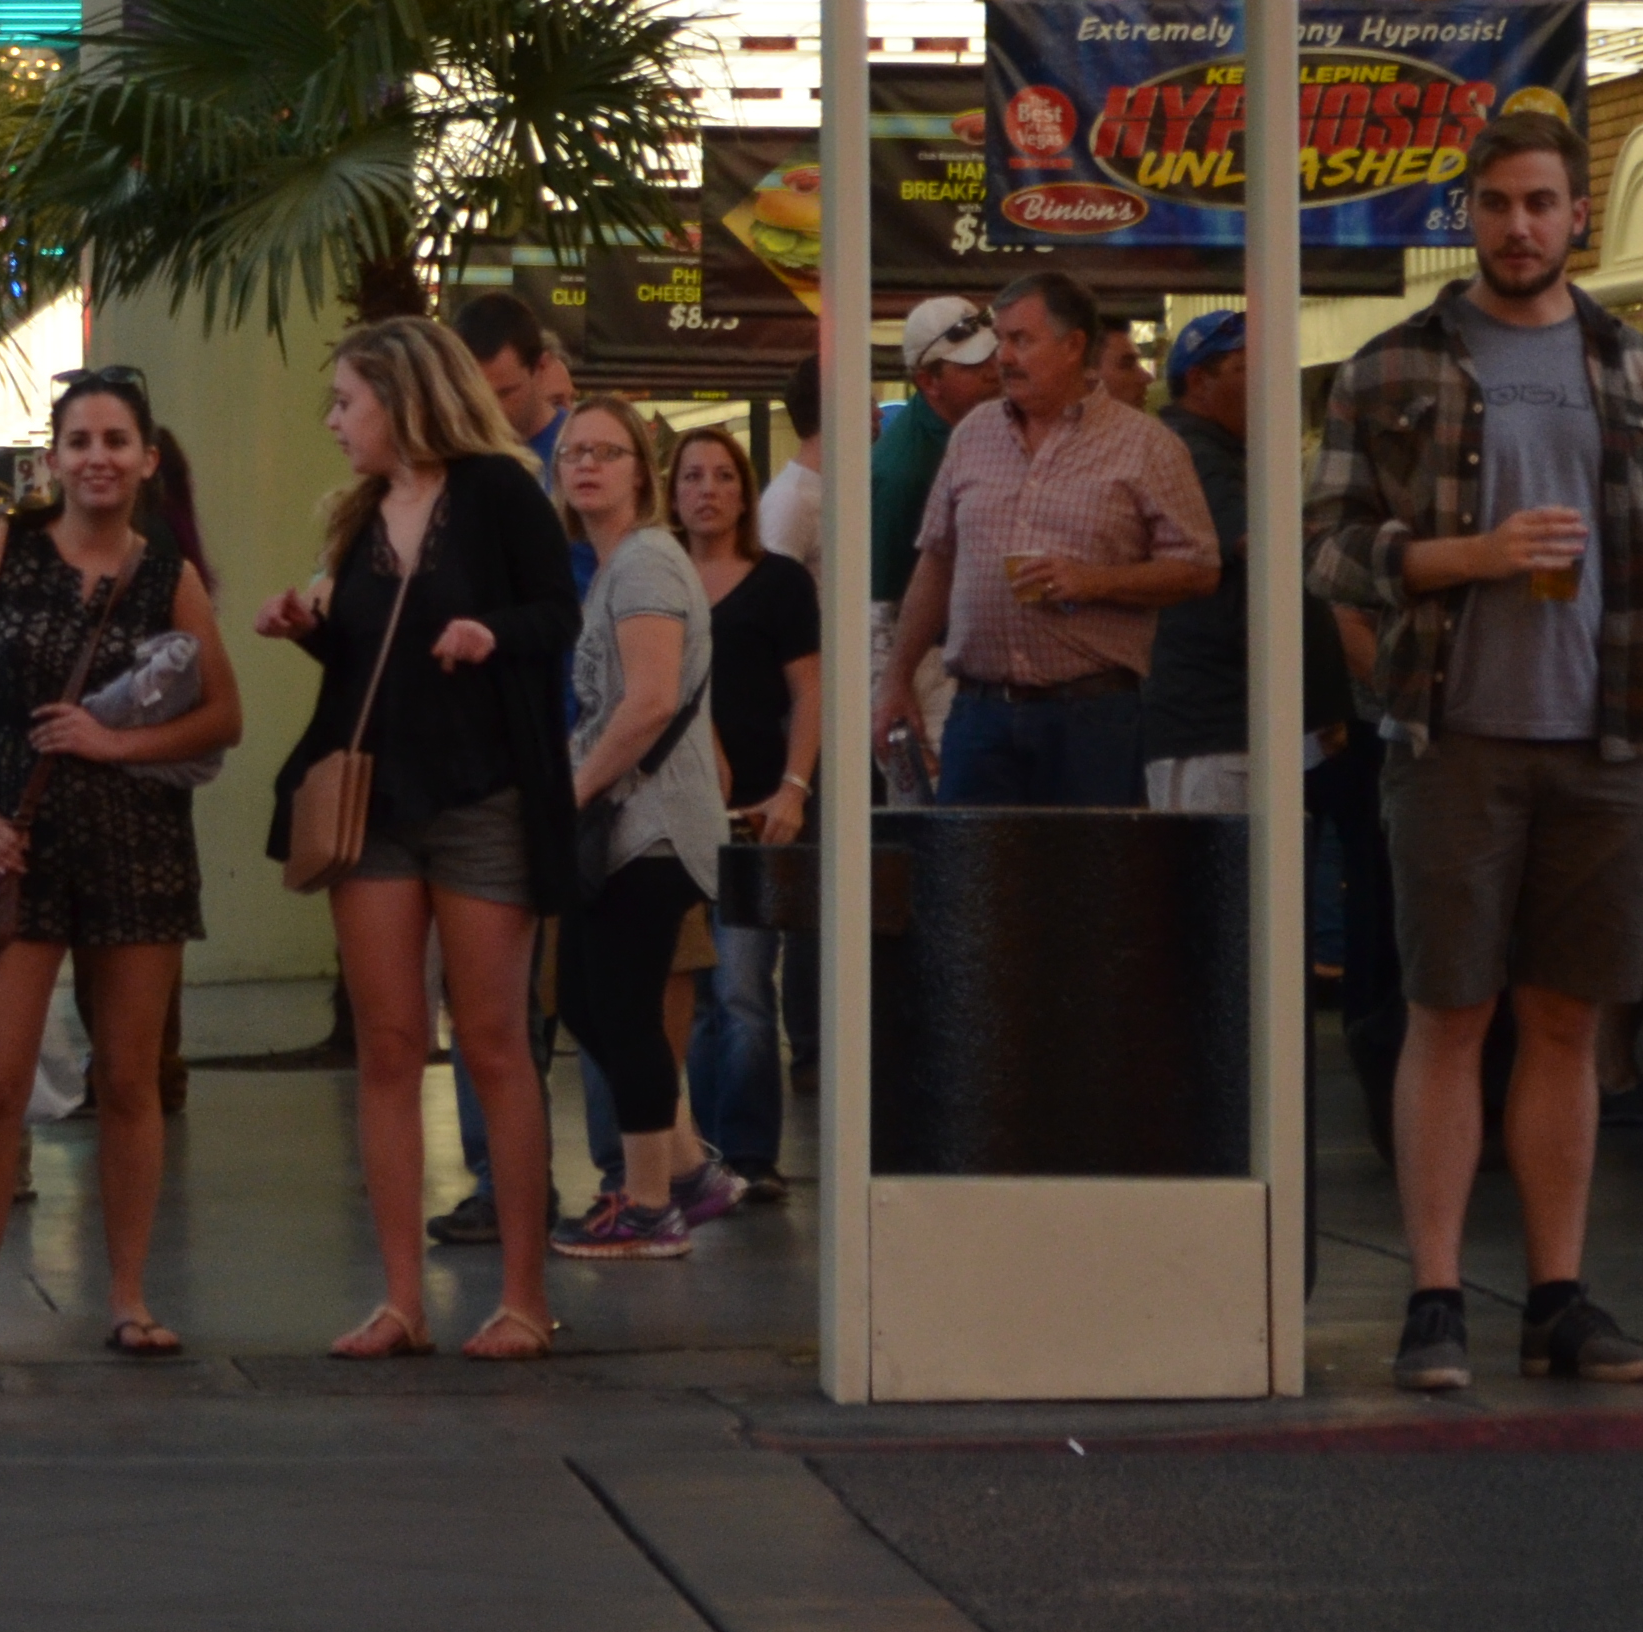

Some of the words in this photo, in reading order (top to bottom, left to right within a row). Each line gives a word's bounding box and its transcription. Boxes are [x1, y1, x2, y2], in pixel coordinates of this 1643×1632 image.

[1077, 17, 1234, 48] Extremely
[1360, 18, 1507, 48] Hypnosis!
[1299, 65, 1400, 83] LEPINE
[1018, 104, 1063, 123] Best
[1017, 131, 1064, 151] Vegas
[1137, 149, 1469, 191] UNLASHED
[1015, 193, 1136, 222] Binion's
[551, 288, 587, 307] CLU
